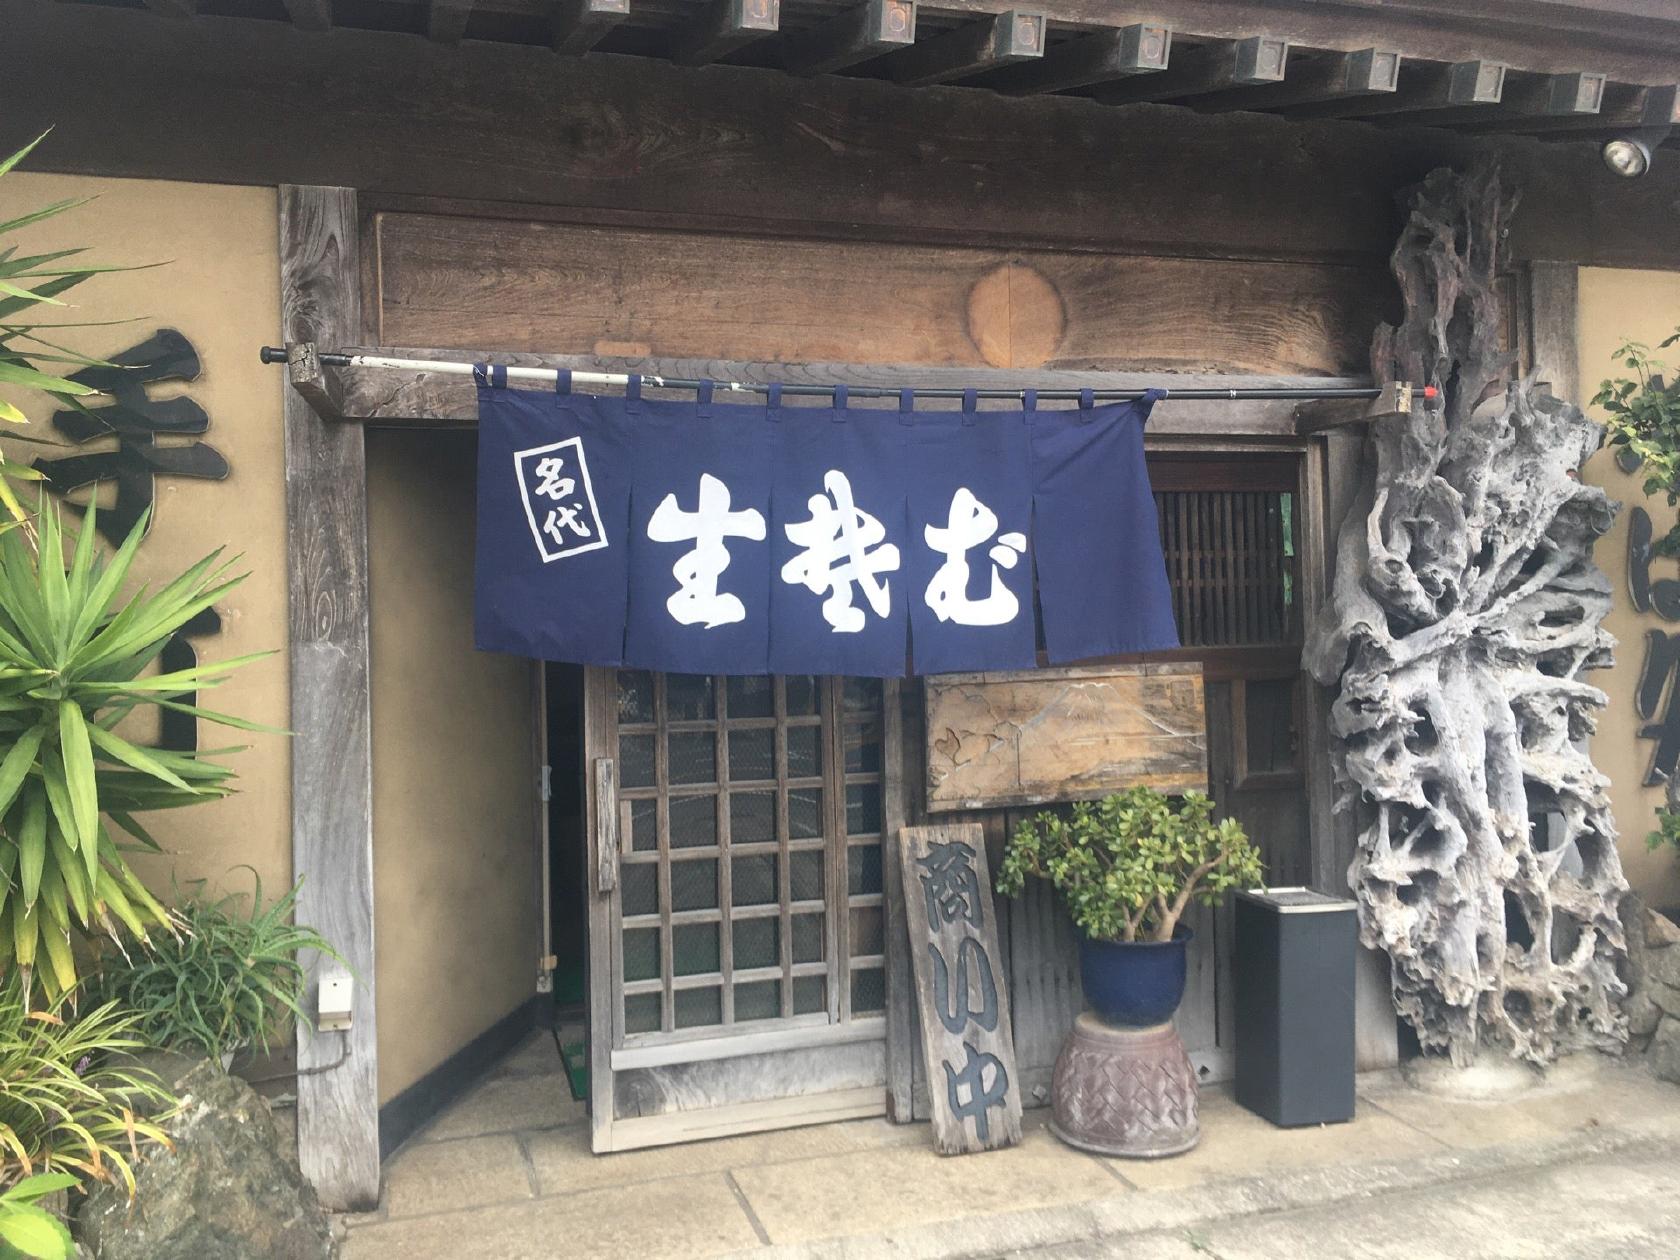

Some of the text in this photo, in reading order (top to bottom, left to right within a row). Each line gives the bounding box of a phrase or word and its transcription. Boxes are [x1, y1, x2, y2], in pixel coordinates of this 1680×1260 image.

[535, 457, 591, 545] 名代
[896, 841, 1009, 1143] 商い中
